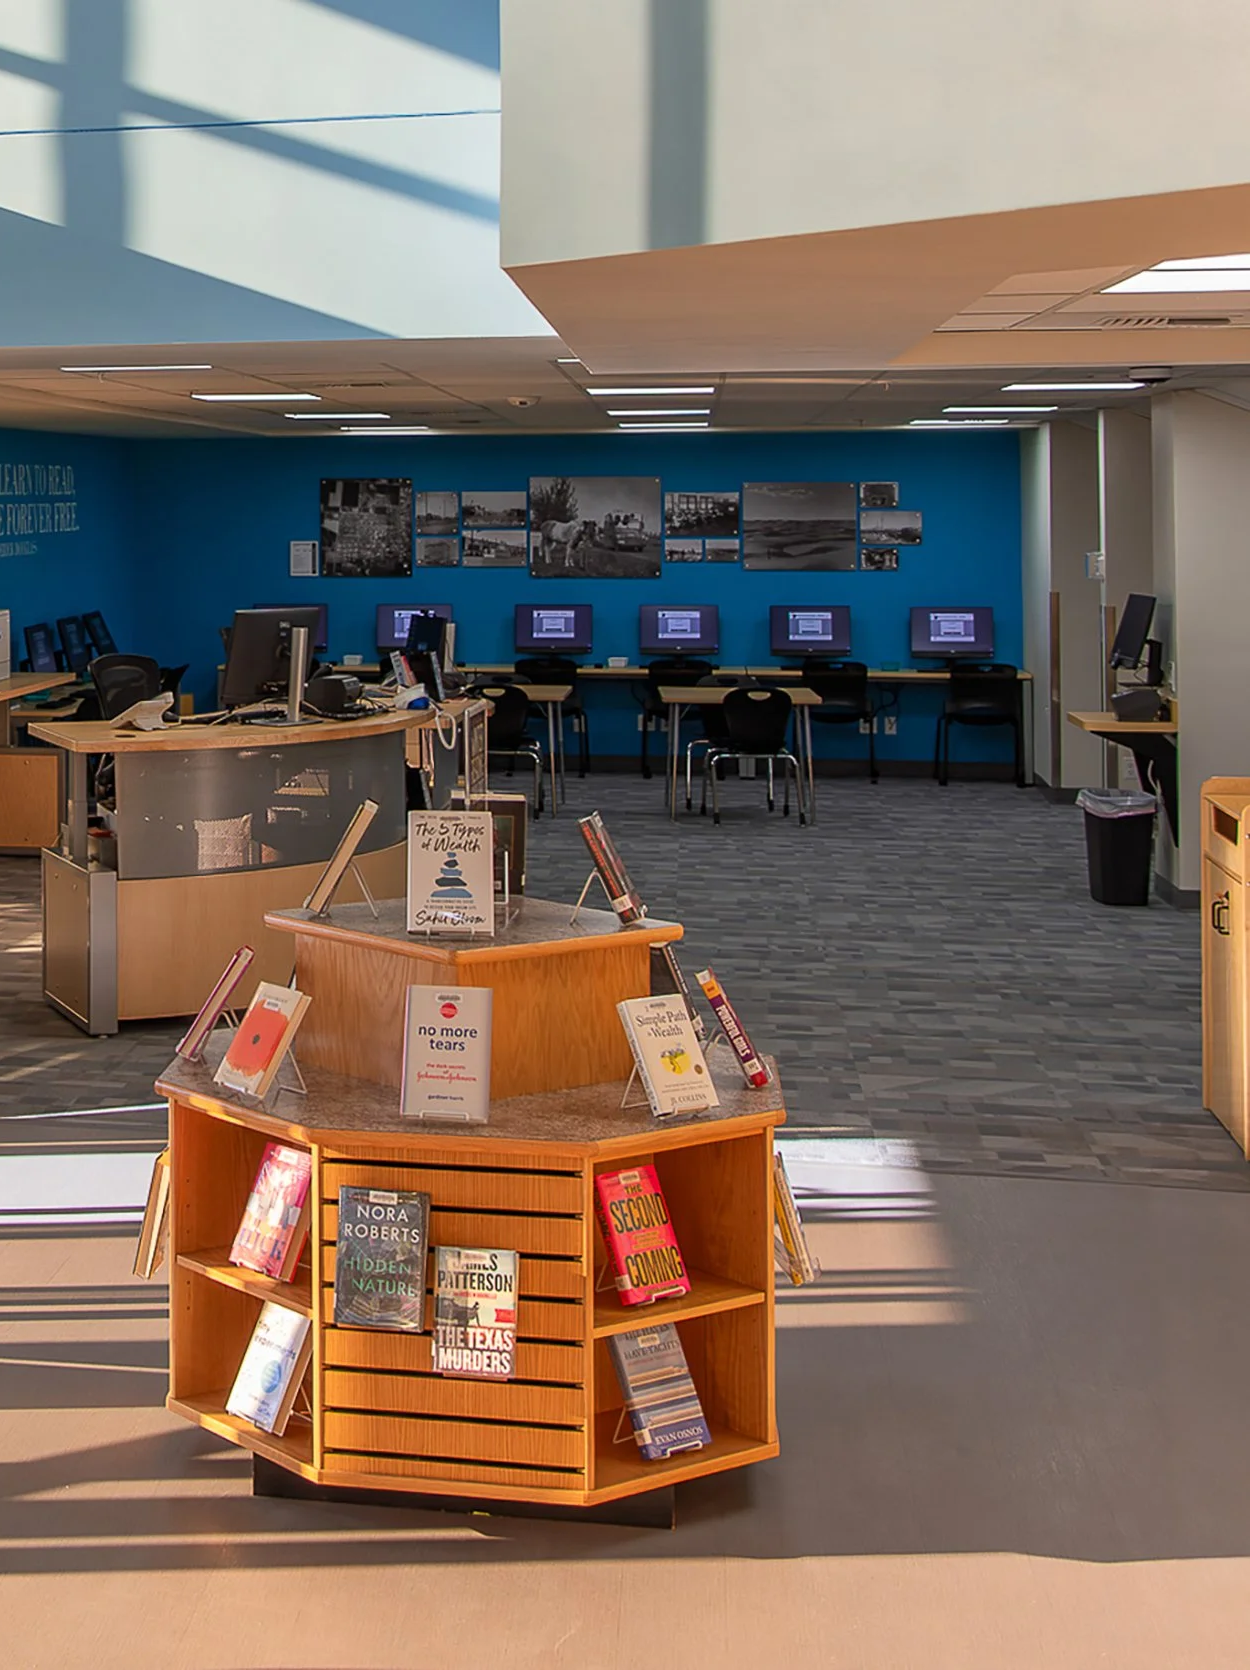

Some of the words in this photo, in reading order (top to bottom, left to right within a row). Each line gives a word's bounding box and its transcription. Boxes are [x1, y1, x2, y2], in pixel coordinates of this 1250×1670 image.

[33, 464, 47, 496] TO
[48, 465, 76, 499] READ,
[6, 503, 51, 536] FOREVER
[54, 502, 80, 532] FREE.
[415, 822, 435, 836] The
[439, 823, 450, 836] 5
[452, 823, 485, 839] Types
[421, 836, 432, 850] of
[434, 837, 481, 852] Wealth
[635, 1013, 666, 1029] Simple
[666, 1010, 688, 1023] Path
[418, 1026, 436, 1036] no
[440, 1027, 478, 1038] more
[651, 1026, 684, 1038] Wealth
[429, 1039, 465, 1051] tears
[624, 1184, 643, 1195] THE
[356, 1205, 409, 1223] NORA
[609, 1192, 669, 1234] SECOND
[344, 1223, 420, 1244] ROBERTS
[343, 1256, 412, 1275] HIDDEN
[624, 1245, 685, 1288] COMING
[351, 1277, 418, 1297] NATURE
[438, 1270, 513, 1292] PATTERSON
[437, 1325, 464, 1347] THE
[466, 1327, 513, 1352] TEXAS
[438, 1347, 511, 1374] MURDERS
[654, 1431, 677, 1445] EVAN
